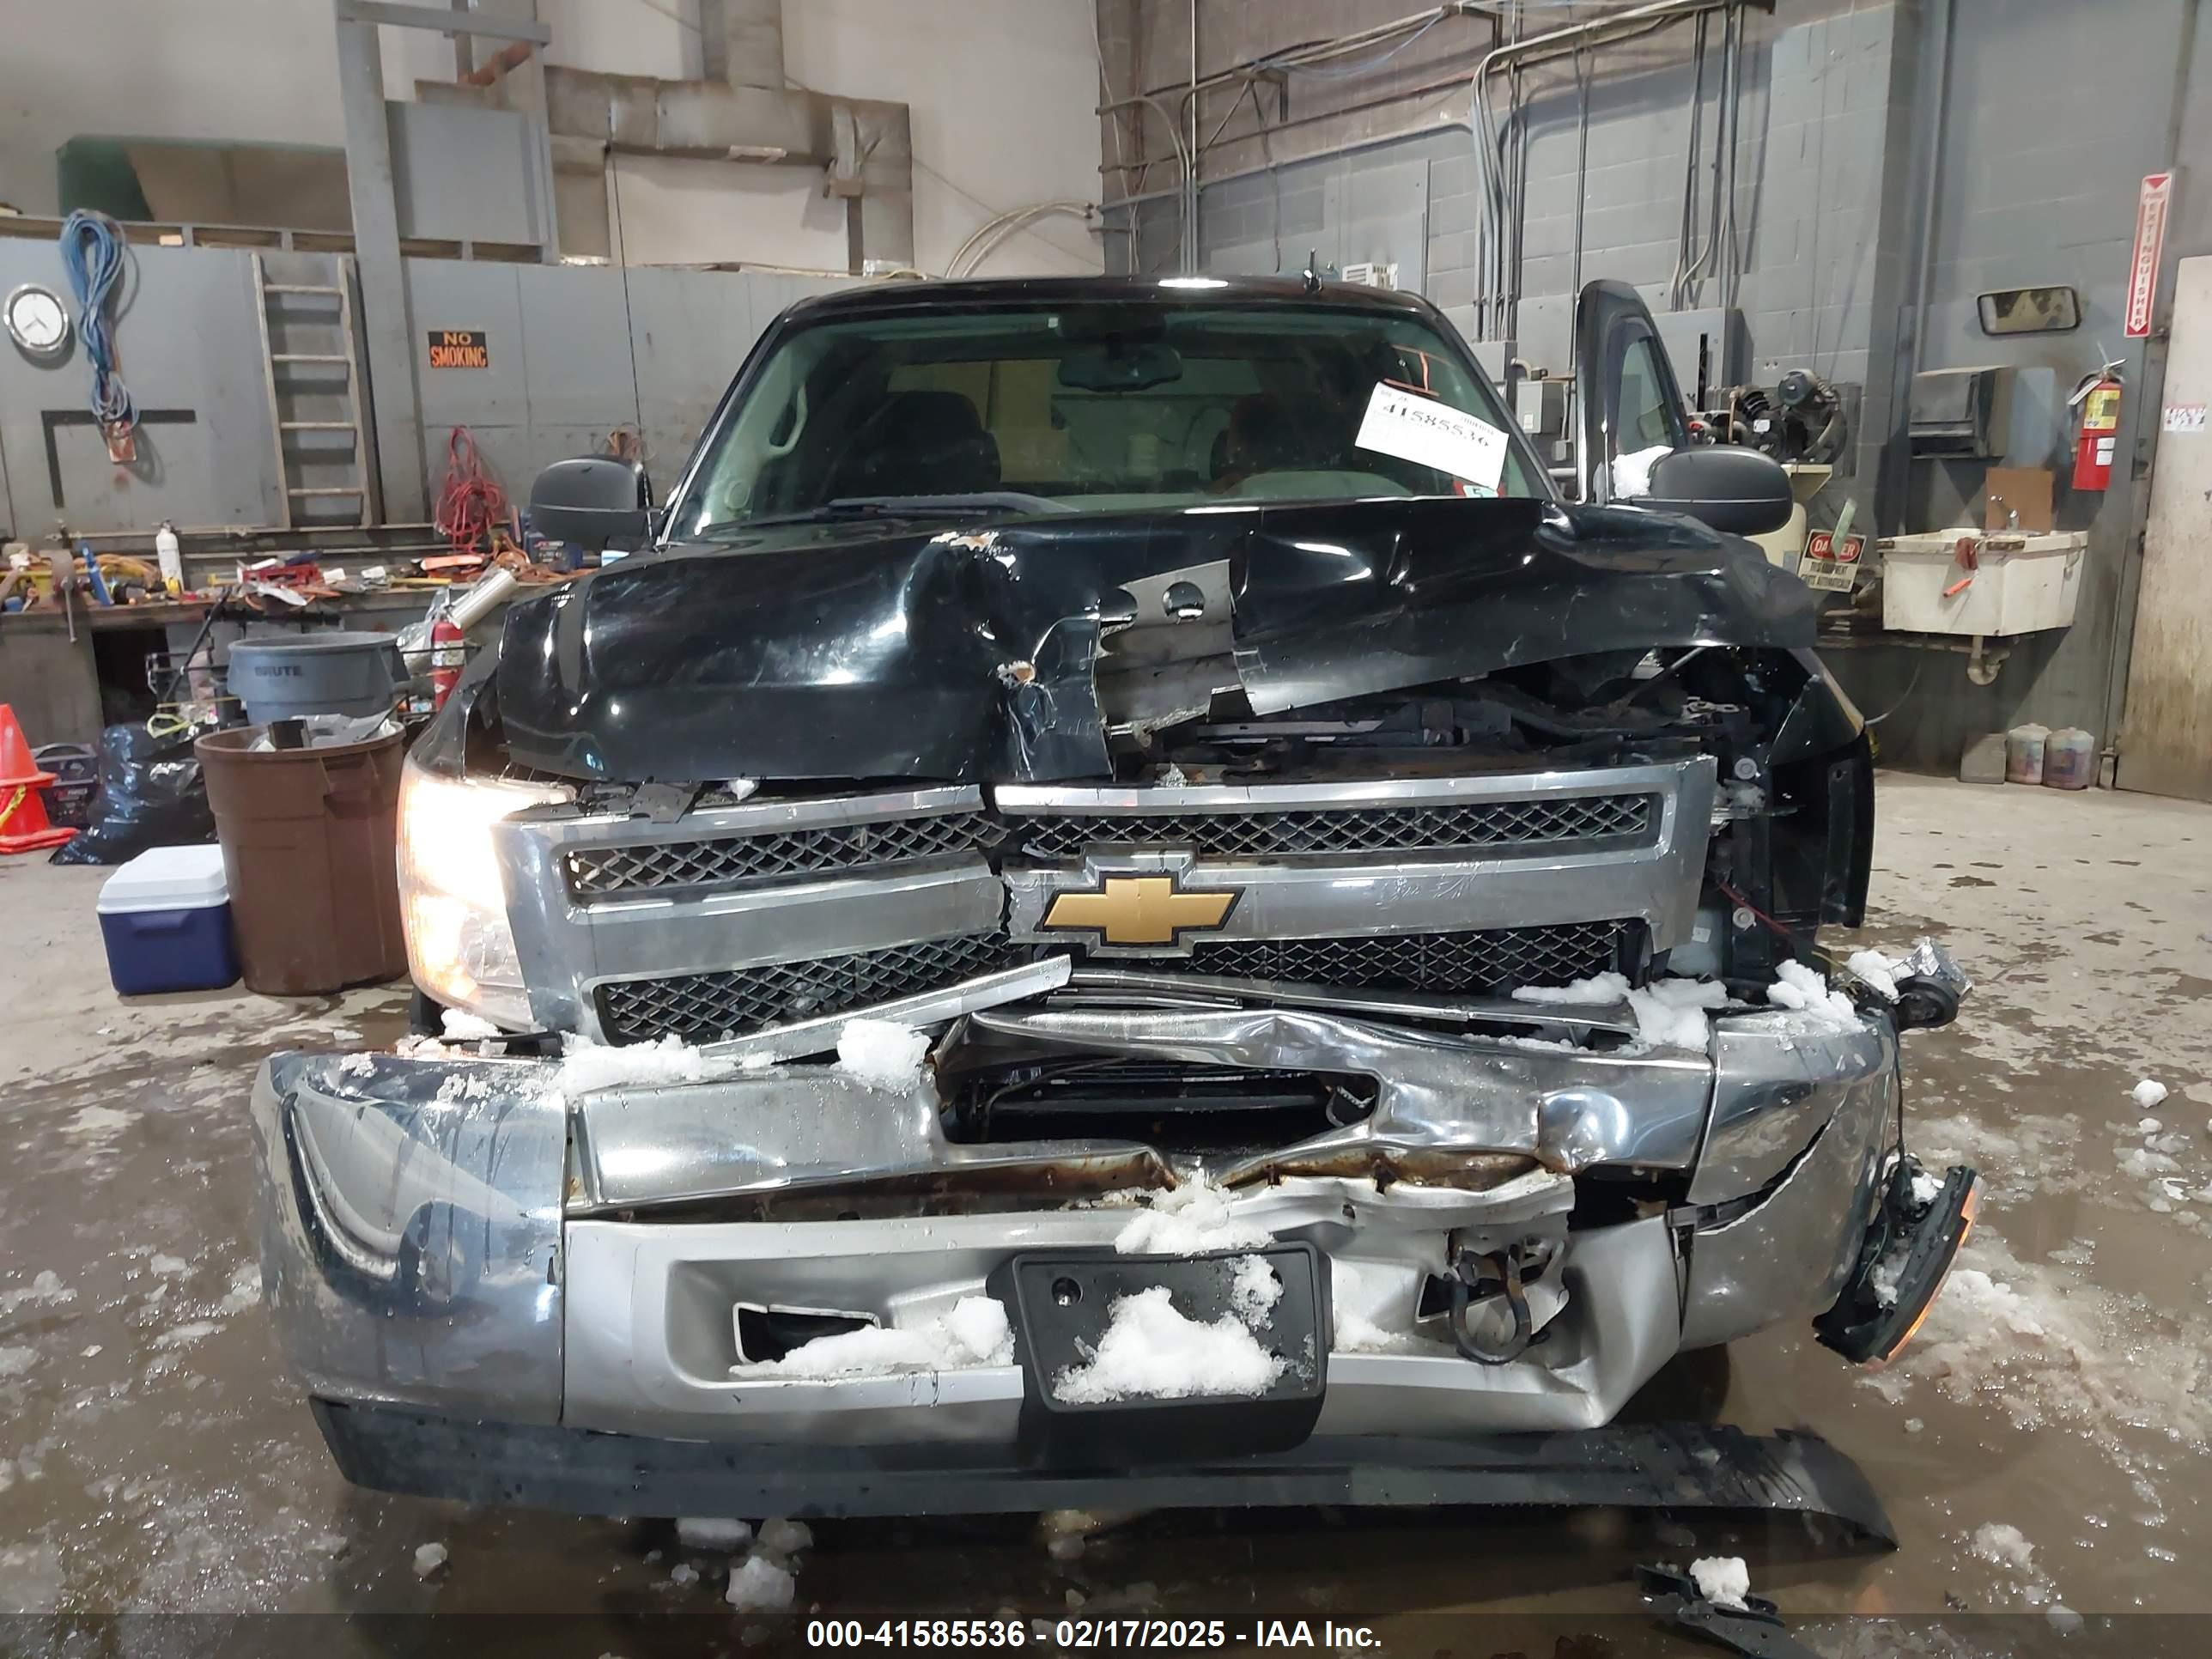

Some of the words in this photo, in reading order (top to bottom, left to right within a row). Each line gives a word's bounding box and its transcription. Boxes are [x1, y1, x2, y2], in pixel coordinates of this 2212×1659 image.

[2134, 202, 2157, 327] EXTINGUISHER
[443, 331, 471, 345] NO
[431, 345, 486, 368] SMOKING
[1814, 538, 1856, 557] DAER
